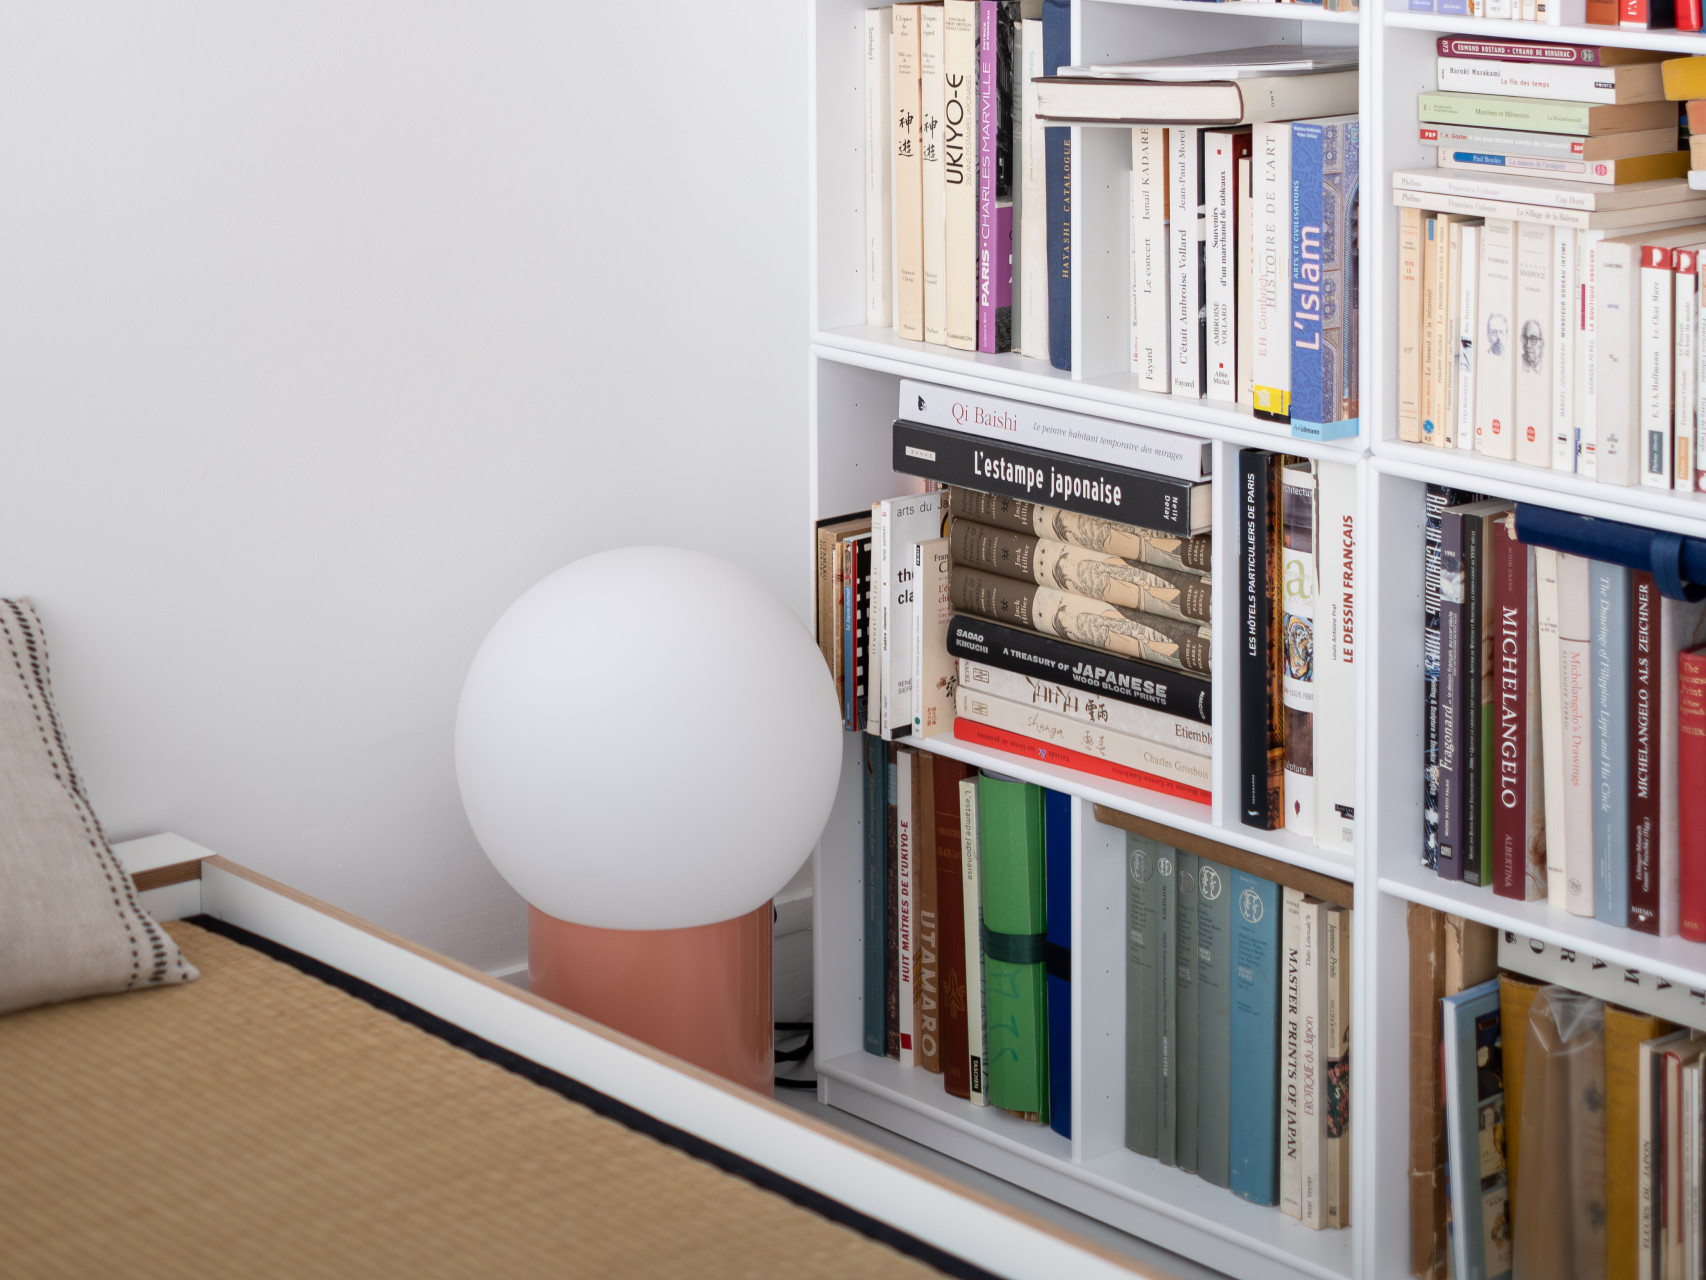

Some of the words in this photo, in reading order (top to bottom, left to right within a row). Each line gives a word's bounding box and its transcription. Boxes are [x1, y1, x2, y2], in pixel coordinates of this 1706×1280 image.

[1450, 67, 1469, 76] Haruki
[1472, 69, 1500, 77] Murakami
[1457, 44, 1479, 52] EDMOND
[1481, 46, 1505, 54] ROSTAND
[1545, 50, 1570, 58] BERGERAC
[945, 73, 964, 185] UKIYO-E
[981, 62, 991, 152] MARVILLE
[1178, 130, 1186, 158] Morel
[981, 155, 991, 238] CHARLES
[1178, 161, 1186, 211] Jean-Paul
[1061, 222, 1070, 278] HAYASHI
[1179, 230, 1187, 268] Vollard
[981, 250, 990, 306] PARIS
[1179, 273, 1187, 325] Ambroise
[1294, 226, 1320, 350] L'Islam
[1179, 328, 1188, 364] C'était
[951, 401, 969, 423] Qi
[973, 404, 1018, 432] Baishi
[1033, 422, 1042, 431] Le
[1044, 423, 1067, 437] peintre
[1068, 428, 1098, 444] habitant
[1100, 435, 1138, 453] temporaire
[1141, 443, 1152, 454] des
[1153, 446, 1183, 461] mirages
[974, 450, 1043, 492] L'estampe
[1050, 468, 1122, 506] japonaise
[1247, 473, 1255, 502] PARIS
[1247, 504, 1255, 519] DE
[1247, 521, 1257, 593] PARTICULIERS
[1341, 515, 1357, 589] FRANÇAIS
[1599, 577, 1609, 595] The
[1245, 595, 1257, 627] HÔTELS
[1343, 592, 1354, 644] DESSIN
[1598, 598, 1610, 645] Drawings
[1638, 584, 1649, 651] ZEICHNER
[955, 639, 989, 654] KIKUCHI
[956, 628, 984, 643] SADAO
[1248, 629, 1257, 656] LES
[1343, 648, 1353, 663] LE
[1598, 648, 1611, 659] of
[1003, 648, 1009, 656] A
[1011, 650, 1056, 668] TREASURY
[1058, 663, 1070, 672] OF
[1072, 661, 1168, 698] JAPANESE
[1073, 674, 1100, 687] WOOD
[1102, 681, 1132, 695] BLOCK
[1134, 691, 1168, 705] PRINTS
[1569, 652, 1582, 733] Michelangelo's
[1598, 661, 1611, 707] Filippino
[1638, 657, 1648, 684] ALS
[1500, 606, 1519, 809] MICHELANGELO
[1598, 710, 1611, 737] Lippi
[1143, 751, 1176, 771] Charles
[1178, 757, 1209, 780] Grosbois
[1570, 735, 1583, 787] Drawings
[1600, 739, 1610, 757] and
[1637, 689, 1649, 799] MICHELANGELO
[1600, 761, 1610, 779] His
[964, 791, 975, 837] L'estampe
[1600, 782, 1611, 813] Circle
[900, 820, 909, 877] L'UKIYO-E
[965, 838, 974, 880] japonaise
[1504, 834, 1514, 887] ALBERTINA
[901, 880, 909, 896] DE
[900, 900, 909, 951] MAÎTRES
[920, 910, 937, 1057] UTAMARO
[1288, 948, 1298, 1015] MASTER
[1287, 1021, 1298, 1079] PRINTS
[1287, 1084, 1298, 1106] OF
[1286, 1108, 1298, 1159] JAPAN
